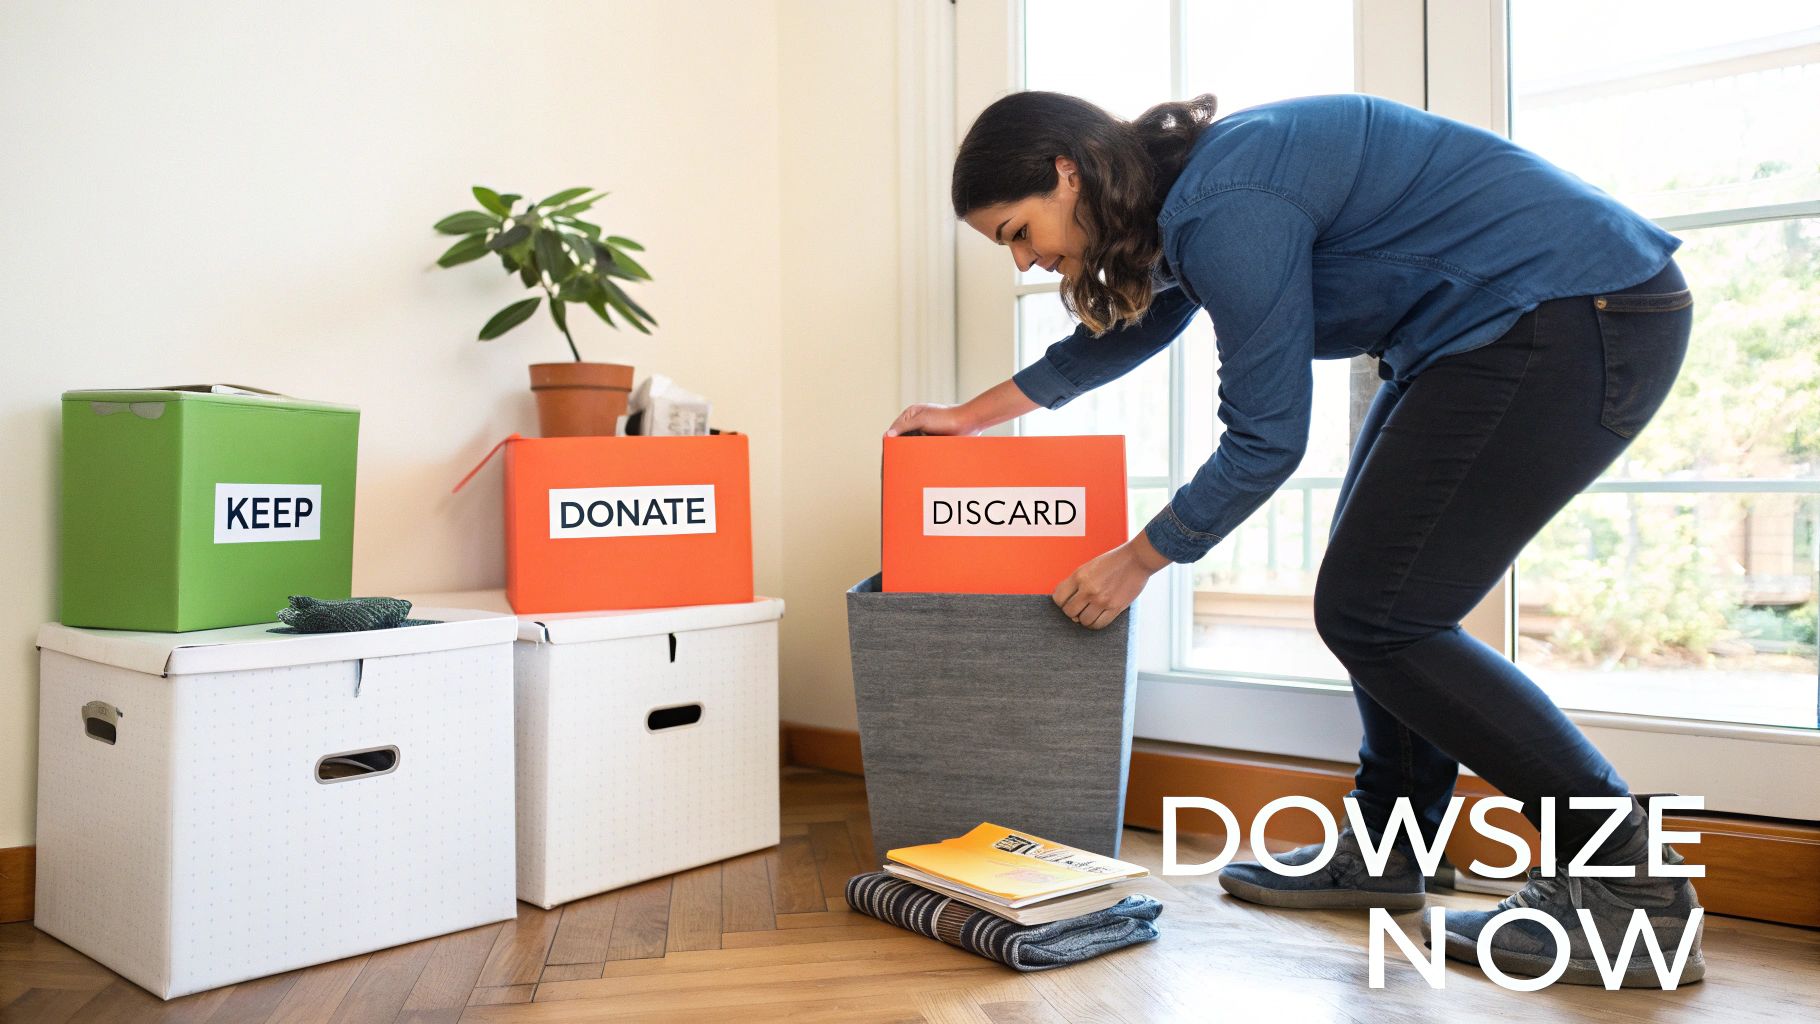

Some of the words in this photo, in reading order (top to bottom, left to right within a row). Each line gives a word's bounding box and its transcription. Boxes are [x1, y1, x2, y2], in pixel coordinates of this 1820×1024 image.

[227, 496, 313, 530] KEEP
[560, 497, 706, 529] DONATE
[933, 500, 1077, 525] DISCARD
